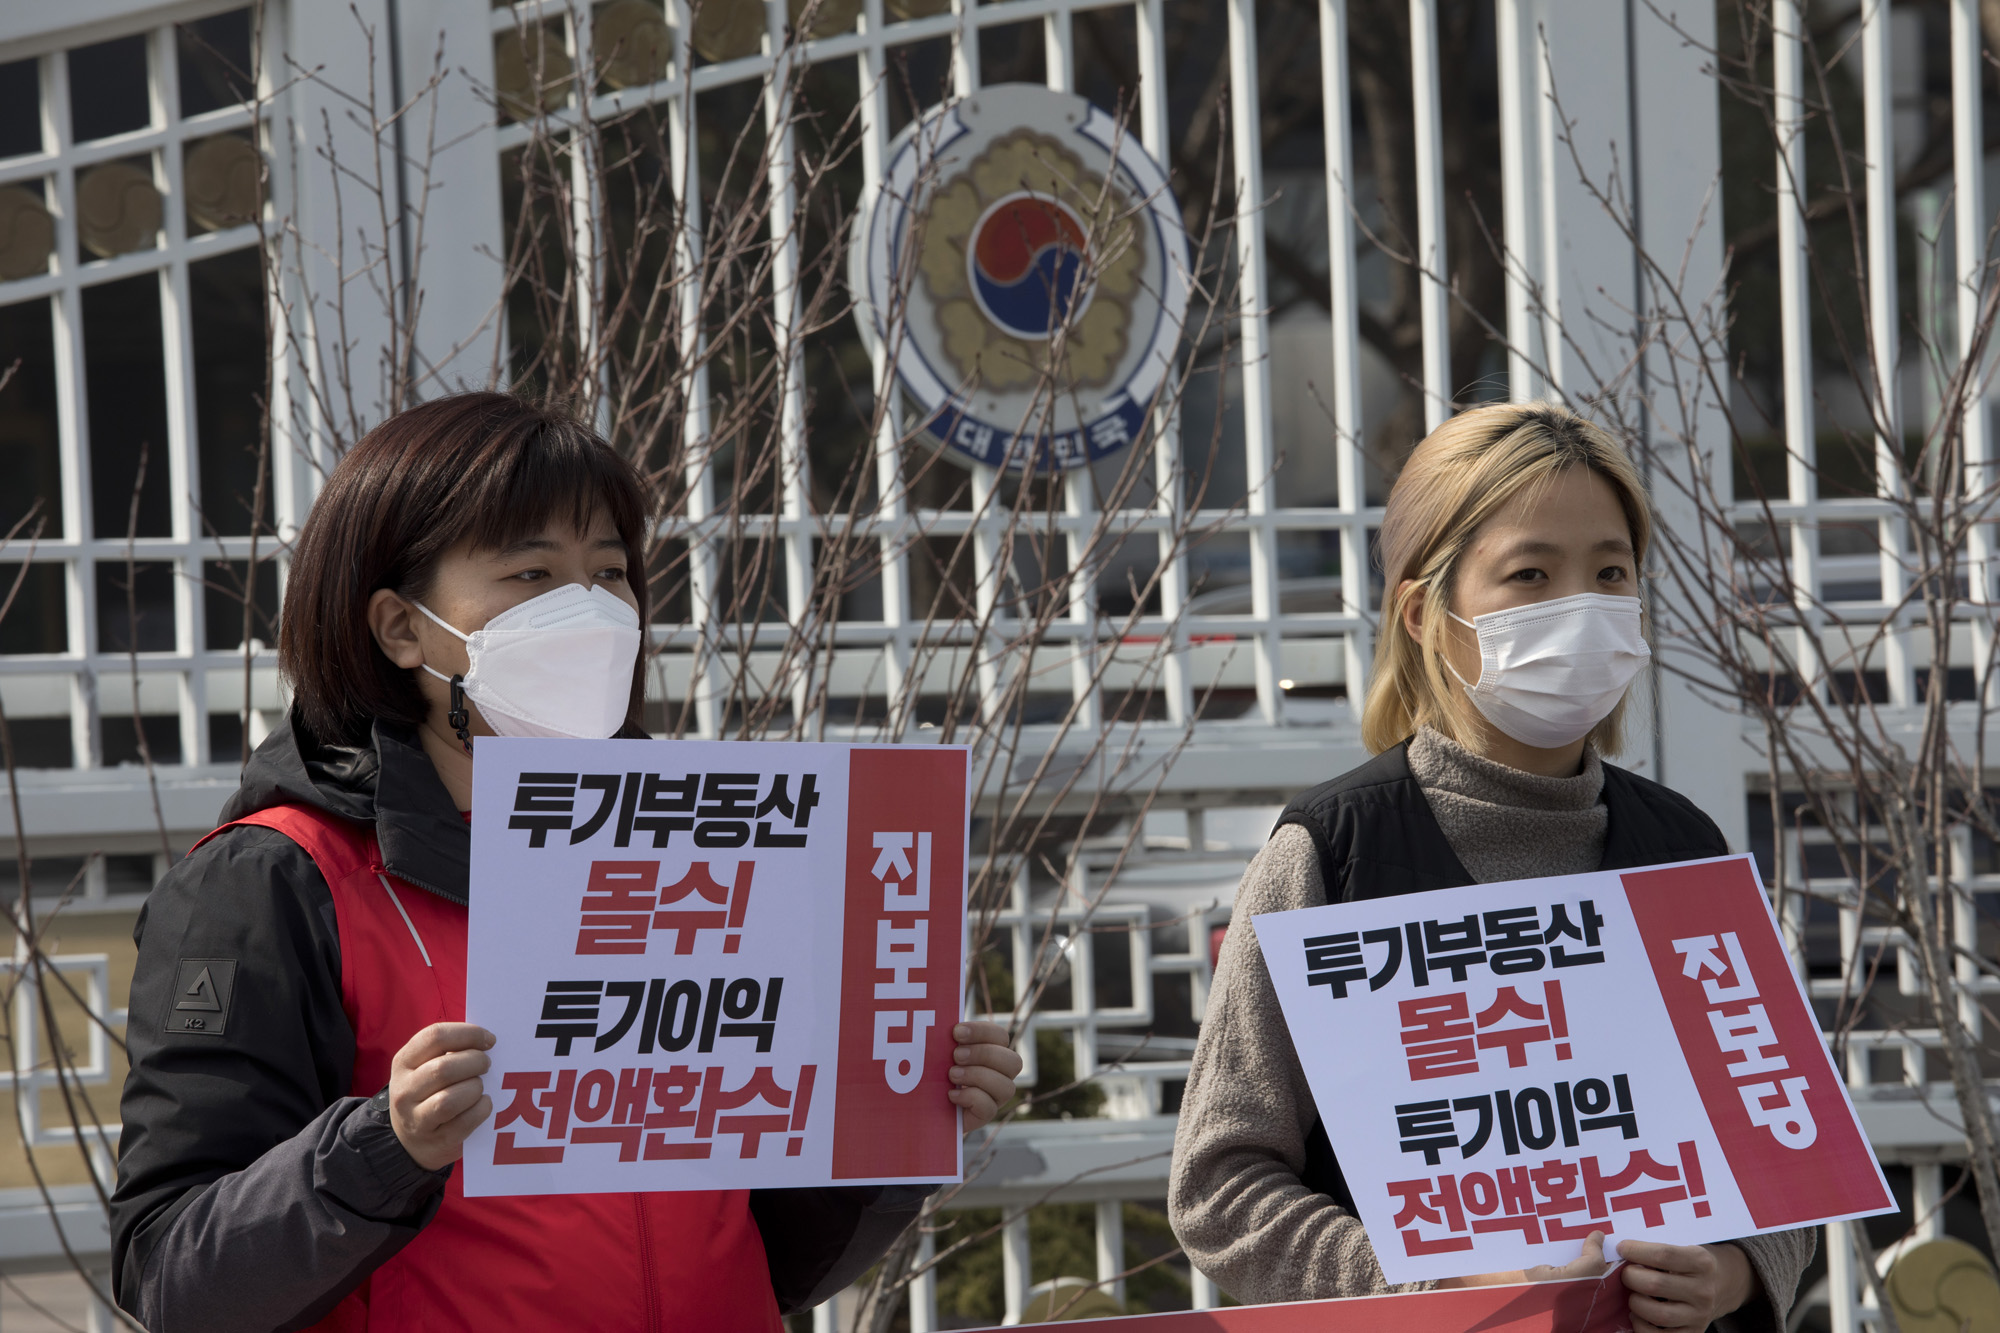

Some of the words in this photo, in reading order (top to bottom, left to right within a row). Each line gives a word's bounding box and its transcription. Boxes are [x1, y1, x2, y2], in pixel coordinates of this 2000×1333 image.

[955, 414, 1129, 467] 대한민국
[508, 772, 820, 848] 투기부동산
[575, 860, 755, 955] 몰수!
[1303, 899, 1606, 999] 투기부동산
[871, 831, 935, 1094] 진보당
[185, 1019, 205, 1029] K2
[535, 977, 784, 1057] 투기이익
[1398, 979, 1573, 1082] 몰수!
[1672, 931, 1818, 1151] 진보당
[493, 1064, 817, 1165] 전액환수!
[1395, 1073, 1639, 1166] 투기이익
[1387, 1140, 1712, 1257] 전액환수!
